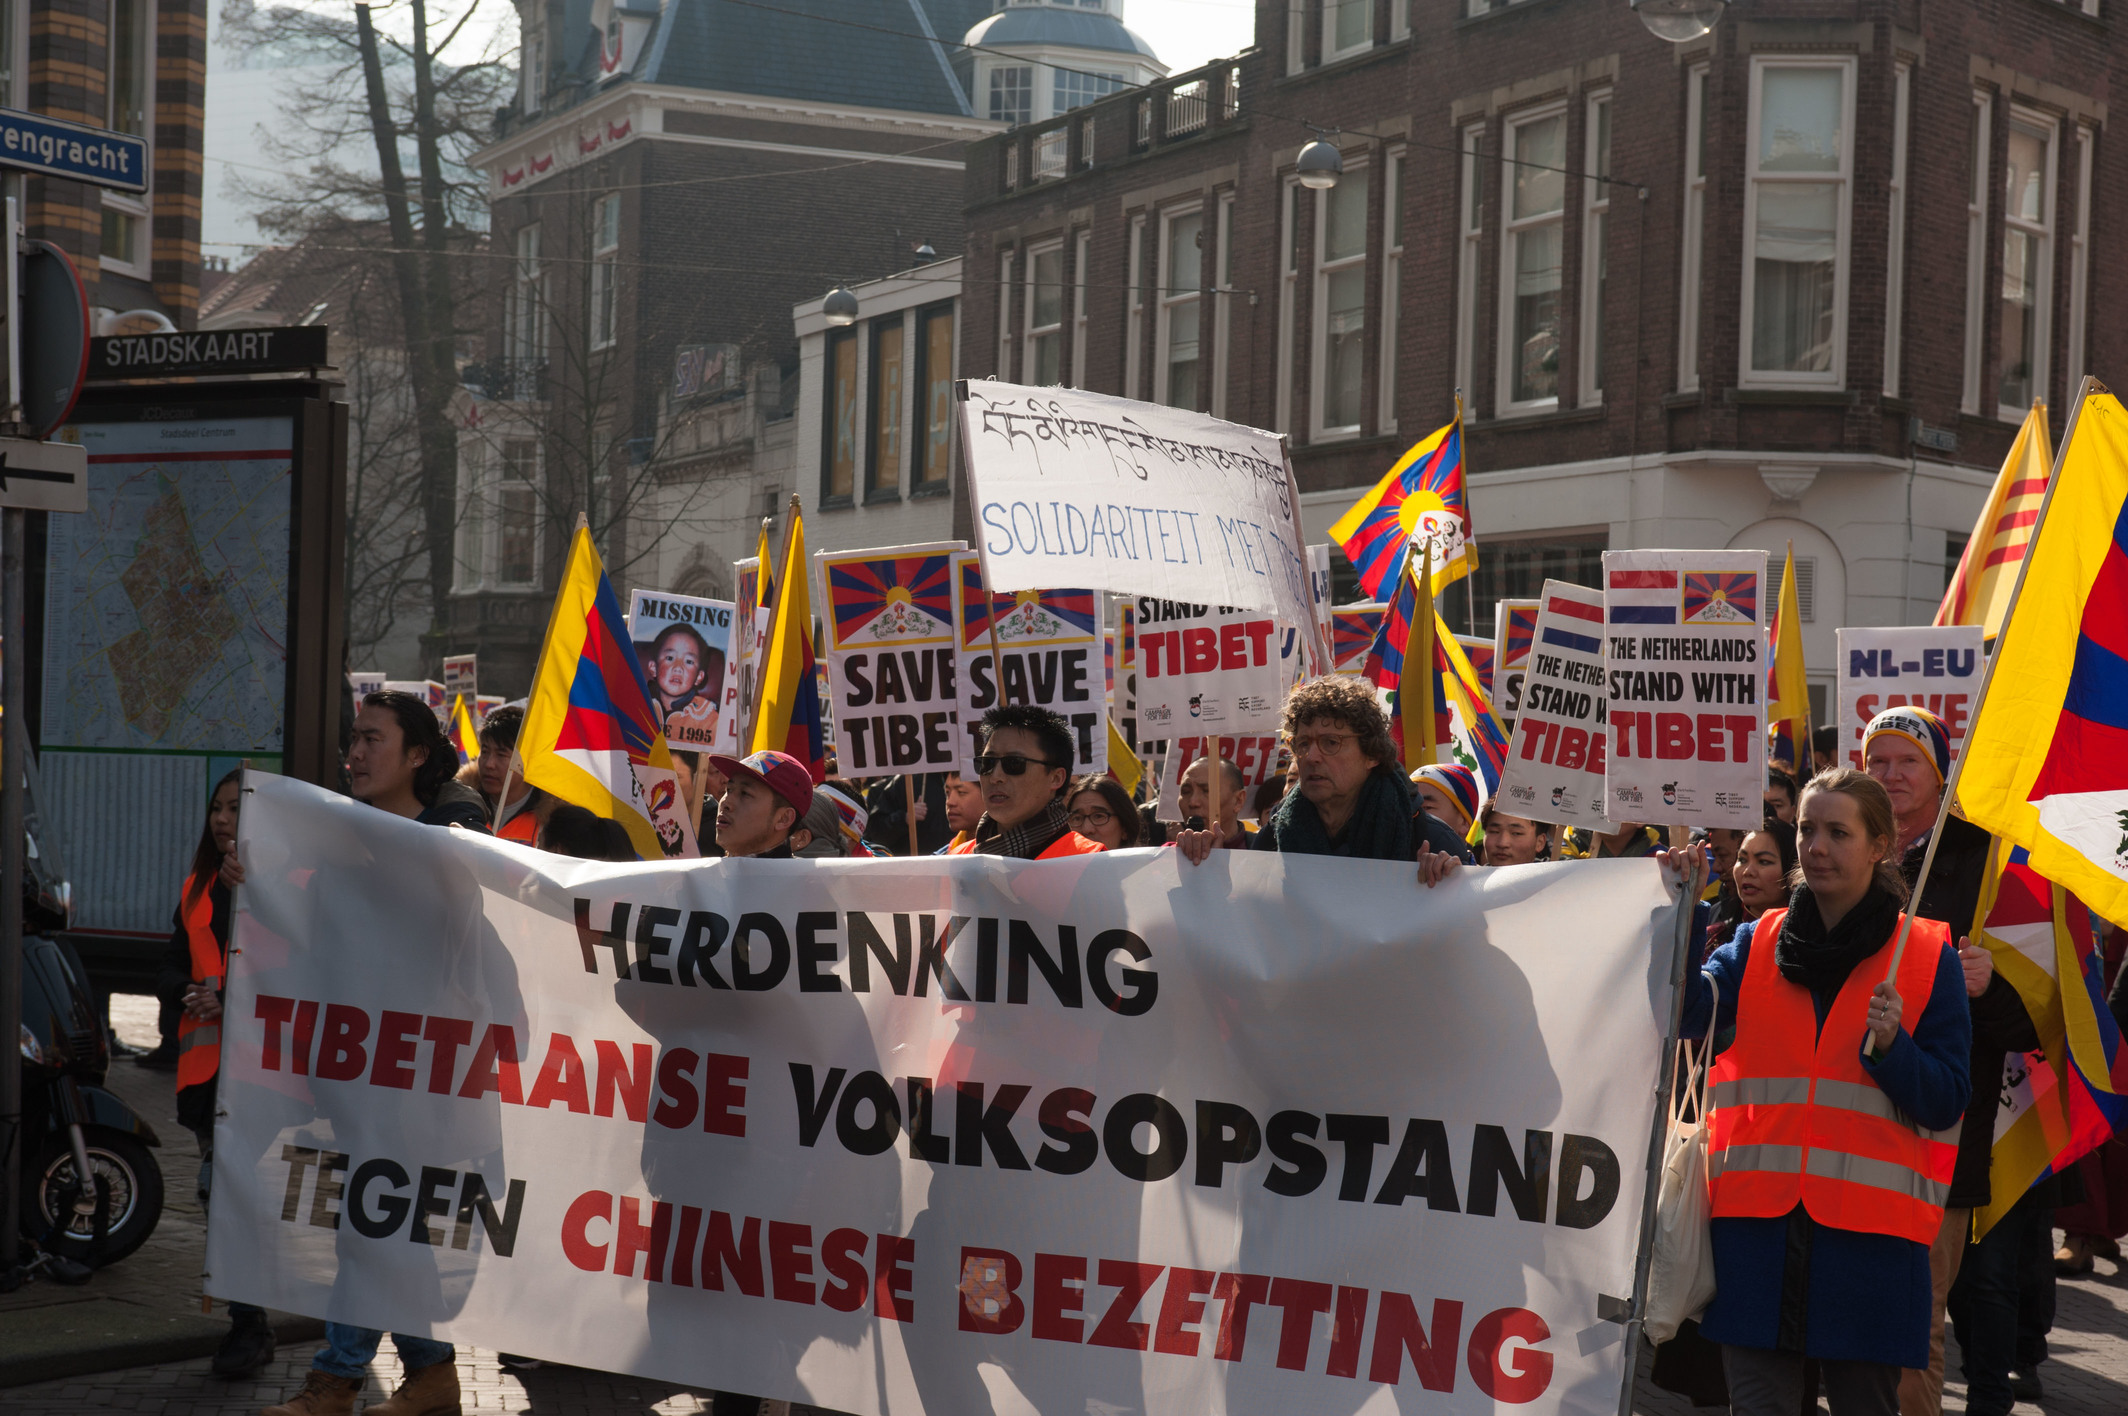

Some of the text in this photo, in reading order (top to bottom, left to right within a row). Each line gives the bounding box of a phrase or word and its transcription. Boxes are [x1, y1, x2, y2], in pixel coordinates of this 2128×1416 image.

[106, 332, 274, 366] STADSKAART
[160, 427, 236, 440] Stadsdeel Centrum
[982, 501, 1203, 565] SOLIDARITEIT
[1216, 514, 1272, 576] MET
[640, 598, 731, 628] MISSING
[1138, 596, 1208, 624] STAND
[1138, 619, 1274, 679] TIBET
[1609, 637, 1756, 663] THE NETHERLANDS
[1849, 648, 1975, 678] NL-EU
[844, 648, 956, 707] SAVE
[970, 649, 1090, 709] SAVE
[1535, 653, 1605, 687] THE NETHE
[1610, 670, 1756, 704] STAND WITH
[1526, 683, 1592, 720] STAND
[679, 726, 712, 744] 1995
[842, 711, 957, 769] TIBE
[1610, 710, 1757, 763] TIBET
[1867, 721, 1927, 740] IBET
[1872, 715, 1921, 729] REE
[1176, 736, 1276, 787] TET
[1521, 717, 1606, 776] TIBE
[573, 897, 1159, 1017] HERDENKING
[254, 994, 1622, 1230] TIBETAANSE VOLKSOPSTAND
[280, 1144, 1555, 1405] TEGEN CHINESE BEZETTING
